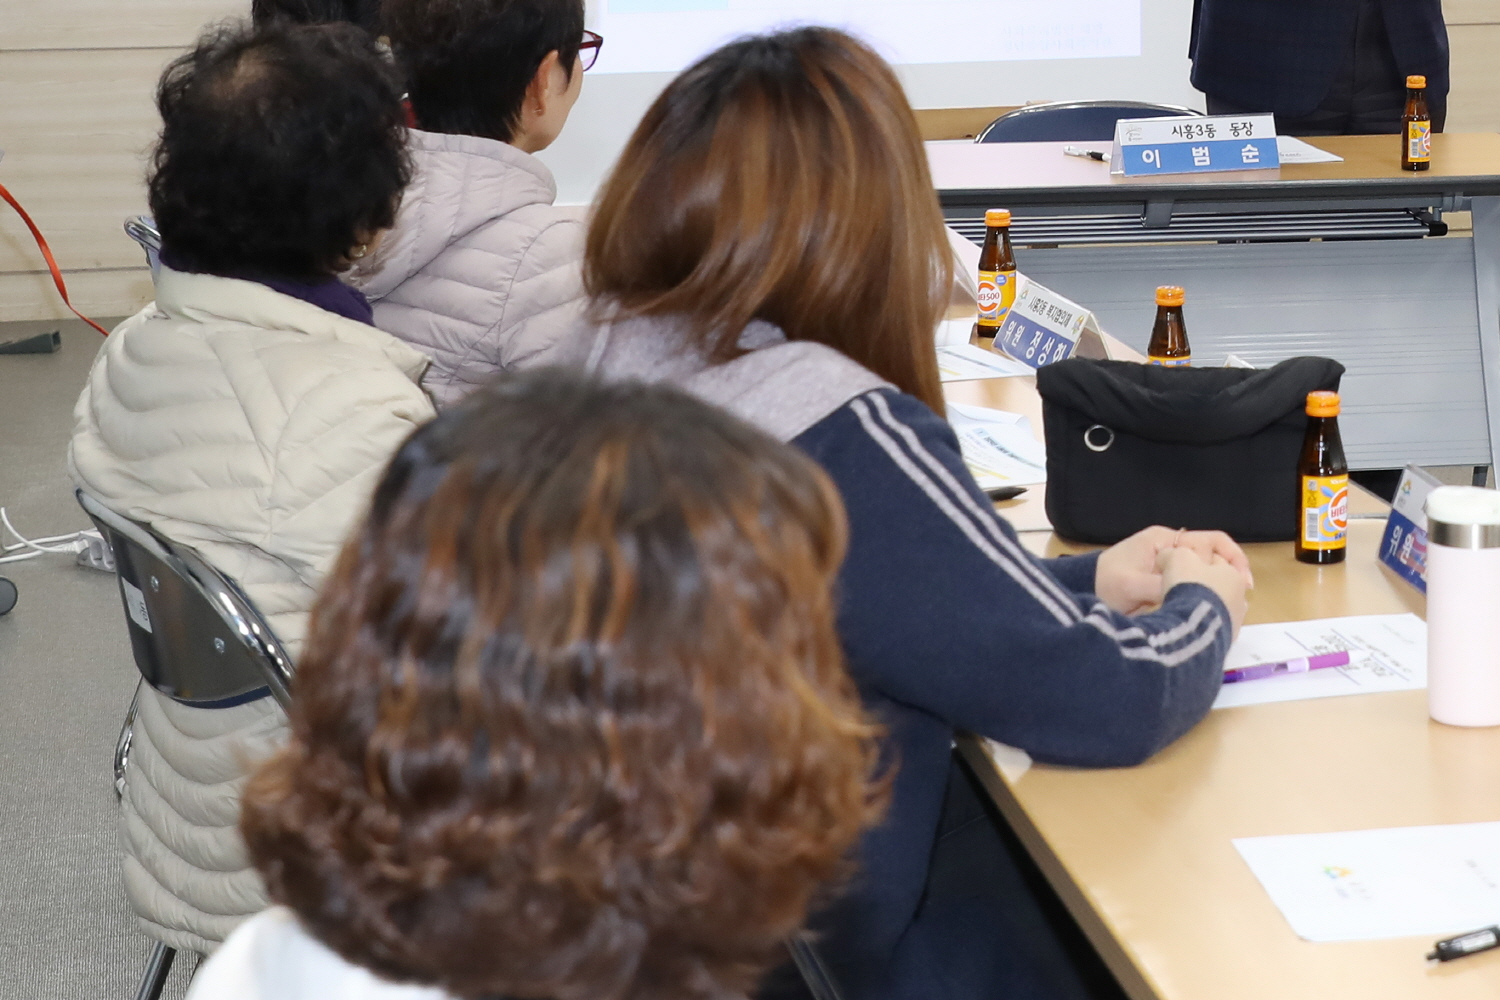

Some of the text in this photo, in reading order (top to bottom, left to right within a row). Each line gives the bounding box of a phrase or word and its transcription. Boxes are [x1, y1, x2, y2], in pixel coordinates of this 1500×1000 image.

[1171, 122, 1253, 139] 시흥3동 동장
[1003, 320, 1025, 347] 위원
